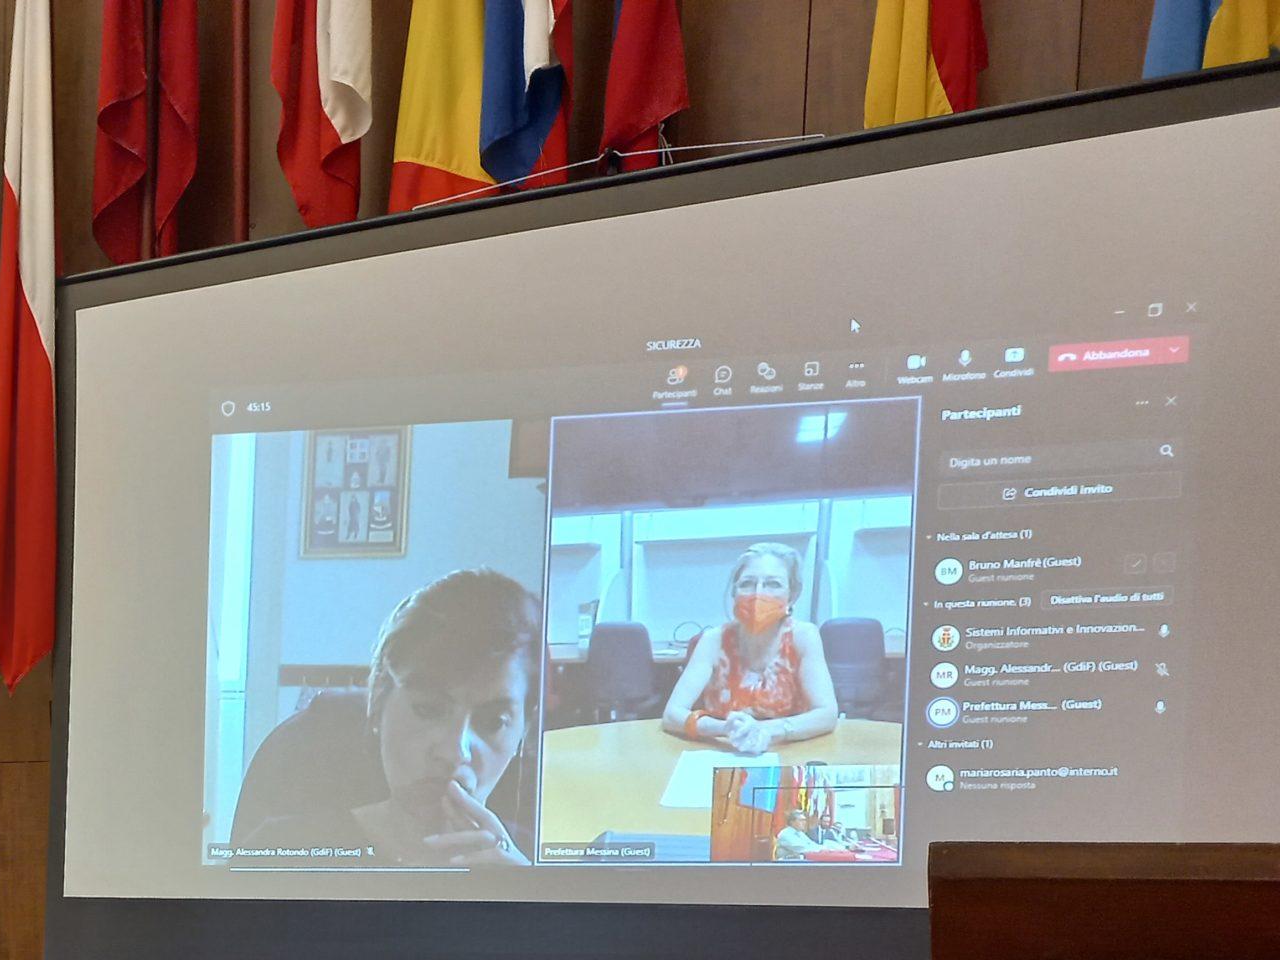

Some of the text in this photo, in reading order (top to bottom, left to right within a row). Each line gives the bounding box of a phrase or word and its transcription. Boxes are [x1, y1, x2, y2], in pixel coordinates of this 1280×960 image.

[646, 338, 701, 351] SICUREZZA
[1083, 348, 1150, 361] Abbandona
[942, 372, 986, 381] Microfono
[993, 368, 1035, 378] Condividi
[897, 376, 933, 385] Webcam
[652, 389, 698, 399] Partecipanti
[713, 387, 732, 396] Chat
[941, 405, 1021, 421] Partecipanti
[949, 455, 1032, 470] Digita un nome
[1024, 484, 1113, 498] Condividi invito
[936, 533, 960, 542] Nella
[962, 532, 979, 541] sala
[1020, 529, 1032, 540] (1)
[969, 560, 1000, 571] Bruno
[1043, 556, 1082, 569] (Guest)
[968, 574, 995, 583] Guest
[1050, 595, 1093, 605] Disattiva
[1129, 592, 1140, 601] di
[1142, 592, 1165, 601] tutti
[945, 599, 975, 610] questa
[965, 627, 1004, 638] Sistemi
[1006, 625, 1064, 636] Informativi
[1066, 626, 1074, 634] e
[965, 641, 1030, 652] Organizzatore
[964, 664, 998, 677] Magg.
[1098, 660, 1138, 672] (Guest)
[936, 671, 953, 679] MR
[963, 678, 990, 687] Guest
[962, 701, 1017, 711] Prefettura
[1061, 699, 1102, 711] (Guest)
[962, 715, 989, 723] Guest
[981, 739, 994, 750] (1)
[211, 848, 234, 858] Magg.
[236, 847, 275, 857] Alessandra
[277, 847, 309, 857] Rotondo
[334, 847, 361, 857] (Guest)
[544, 847, 651, 857] Prefettura Messina (Guest)
